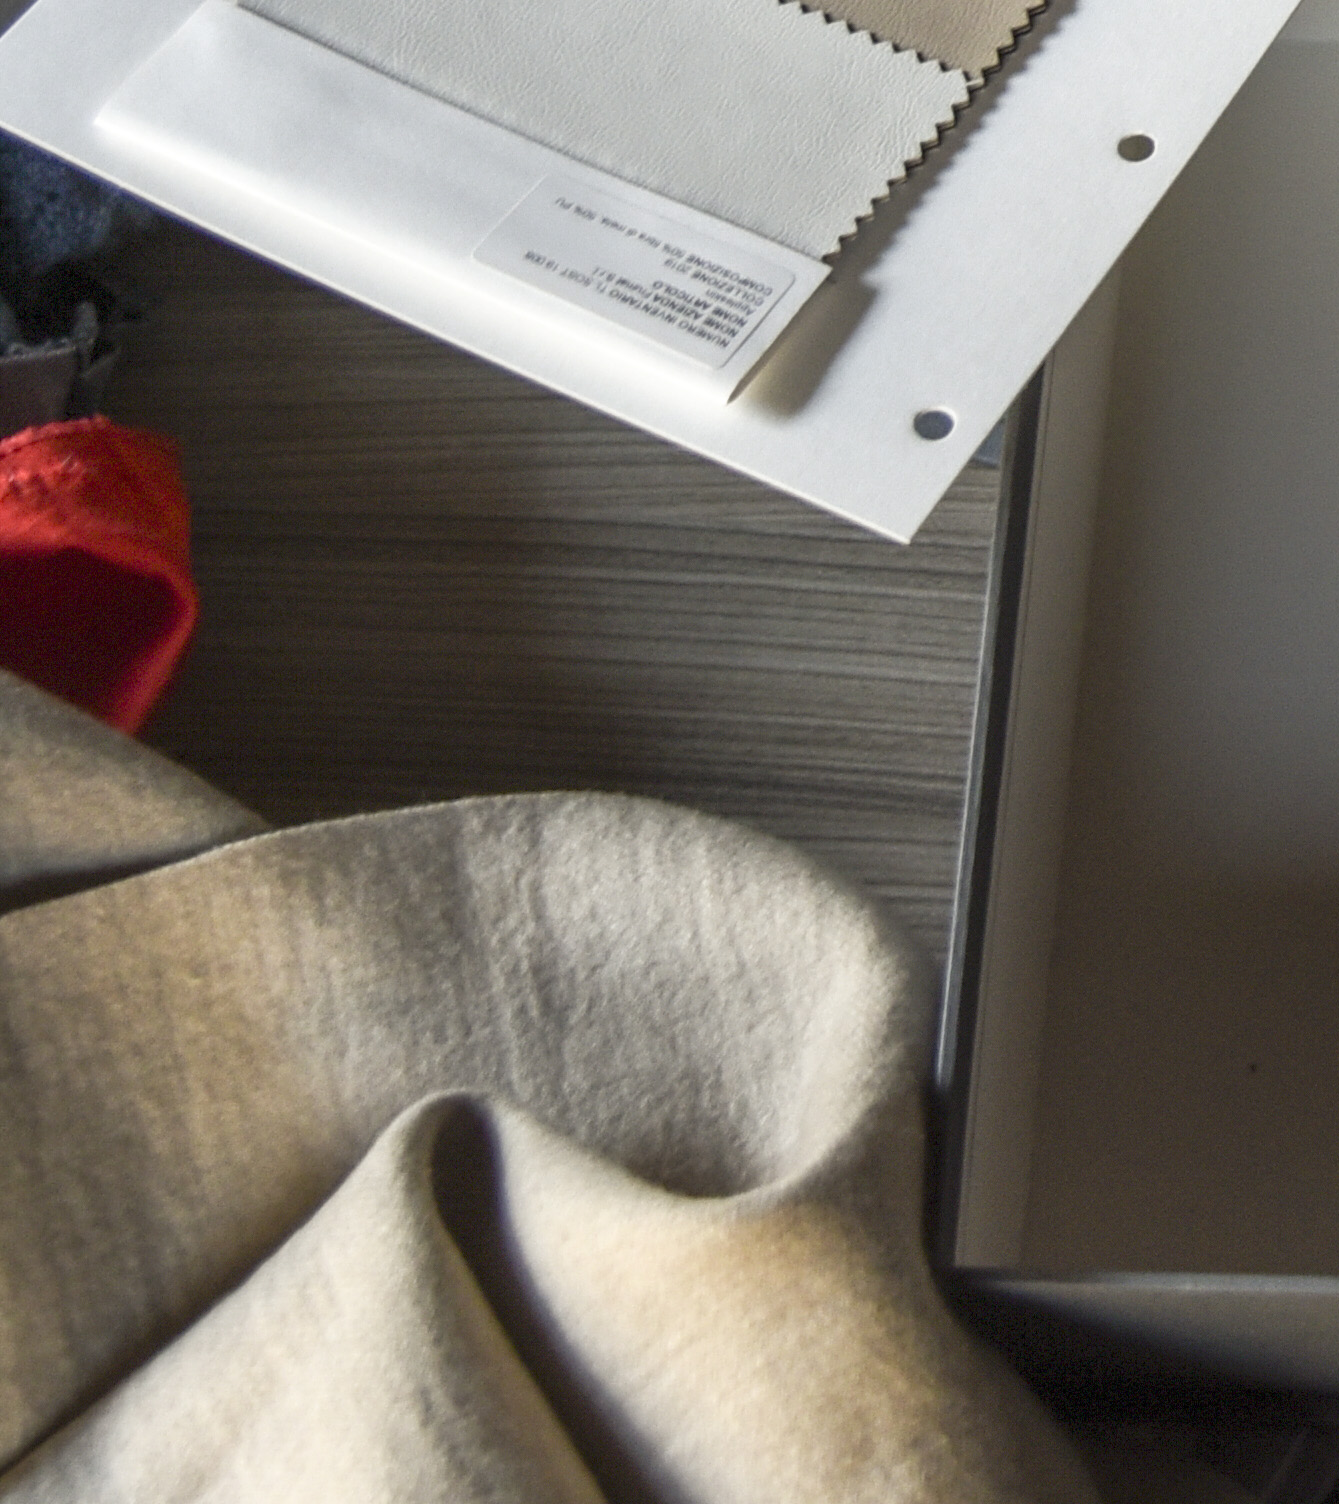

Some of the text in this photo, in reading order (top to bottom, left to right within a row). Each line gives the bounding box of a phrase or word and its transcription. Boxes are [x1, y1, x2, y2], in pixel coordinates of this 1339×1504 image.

[664, 258, 764, 307] COLLEZIONE 2019
[686, 255, 773, 297] COMPOSIZIONE
[609, 289, 677, 324] INVENTARIO
[652, 281, 747, 328] NOME ARTICOLO
[652, 294, 703, 321] AZIENDA
[678, 320, 730, 348] NUMERO
[703, 317, 738, 338] NOME
